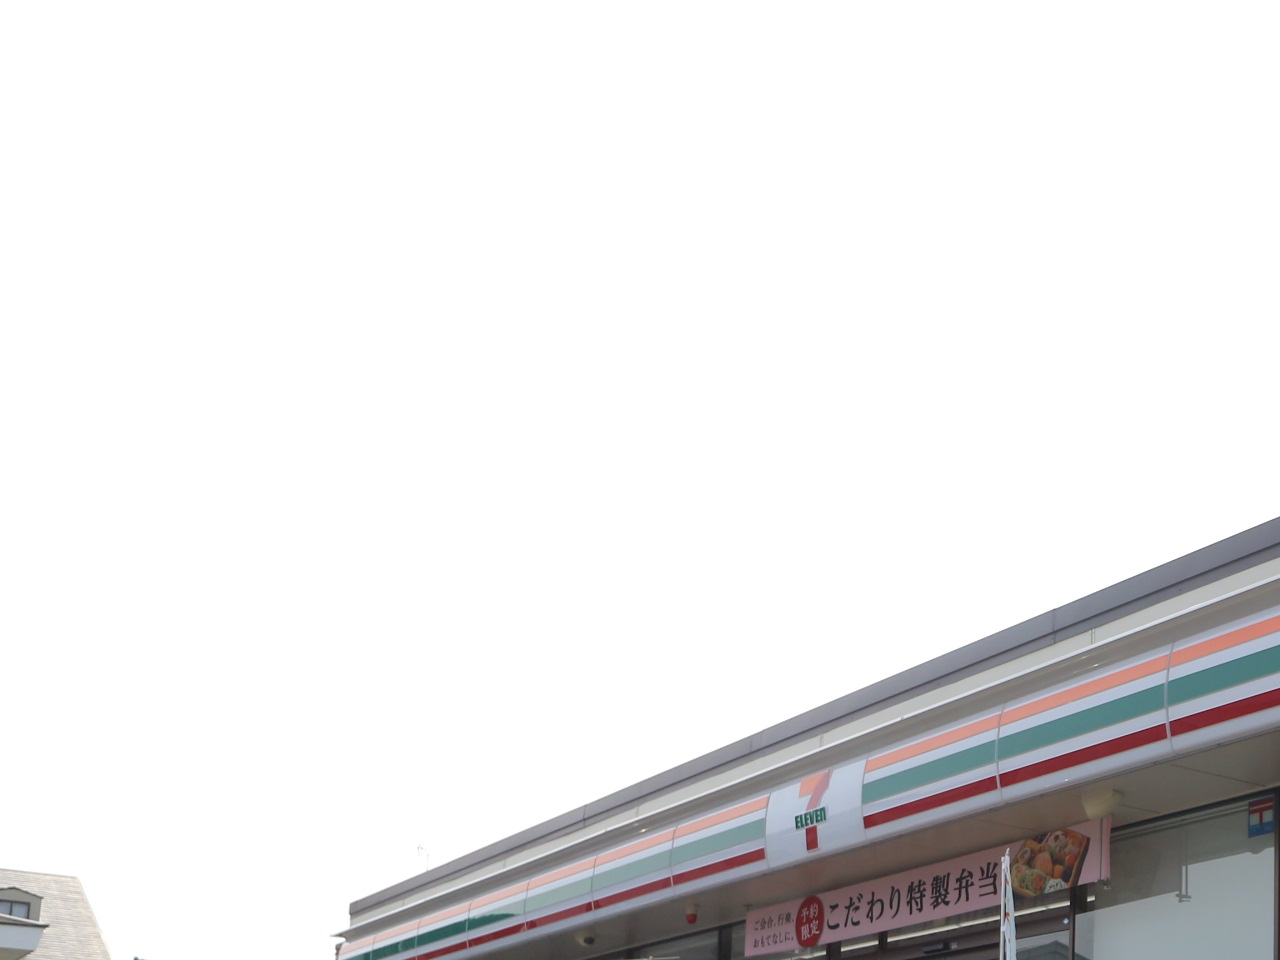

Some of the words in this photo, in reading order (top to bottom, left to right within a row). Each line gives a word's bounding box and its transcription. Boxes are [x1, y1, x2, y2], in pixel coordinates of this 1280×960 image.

[794, 806, 828, 830] ELEVEN
[826, 862, 999, 930] こだわり特製弁当
[800, 903, 819, 923] 予約
[753, 931, 795, 949] おもてなしに。
[801, 921, 820, 941] 限定
